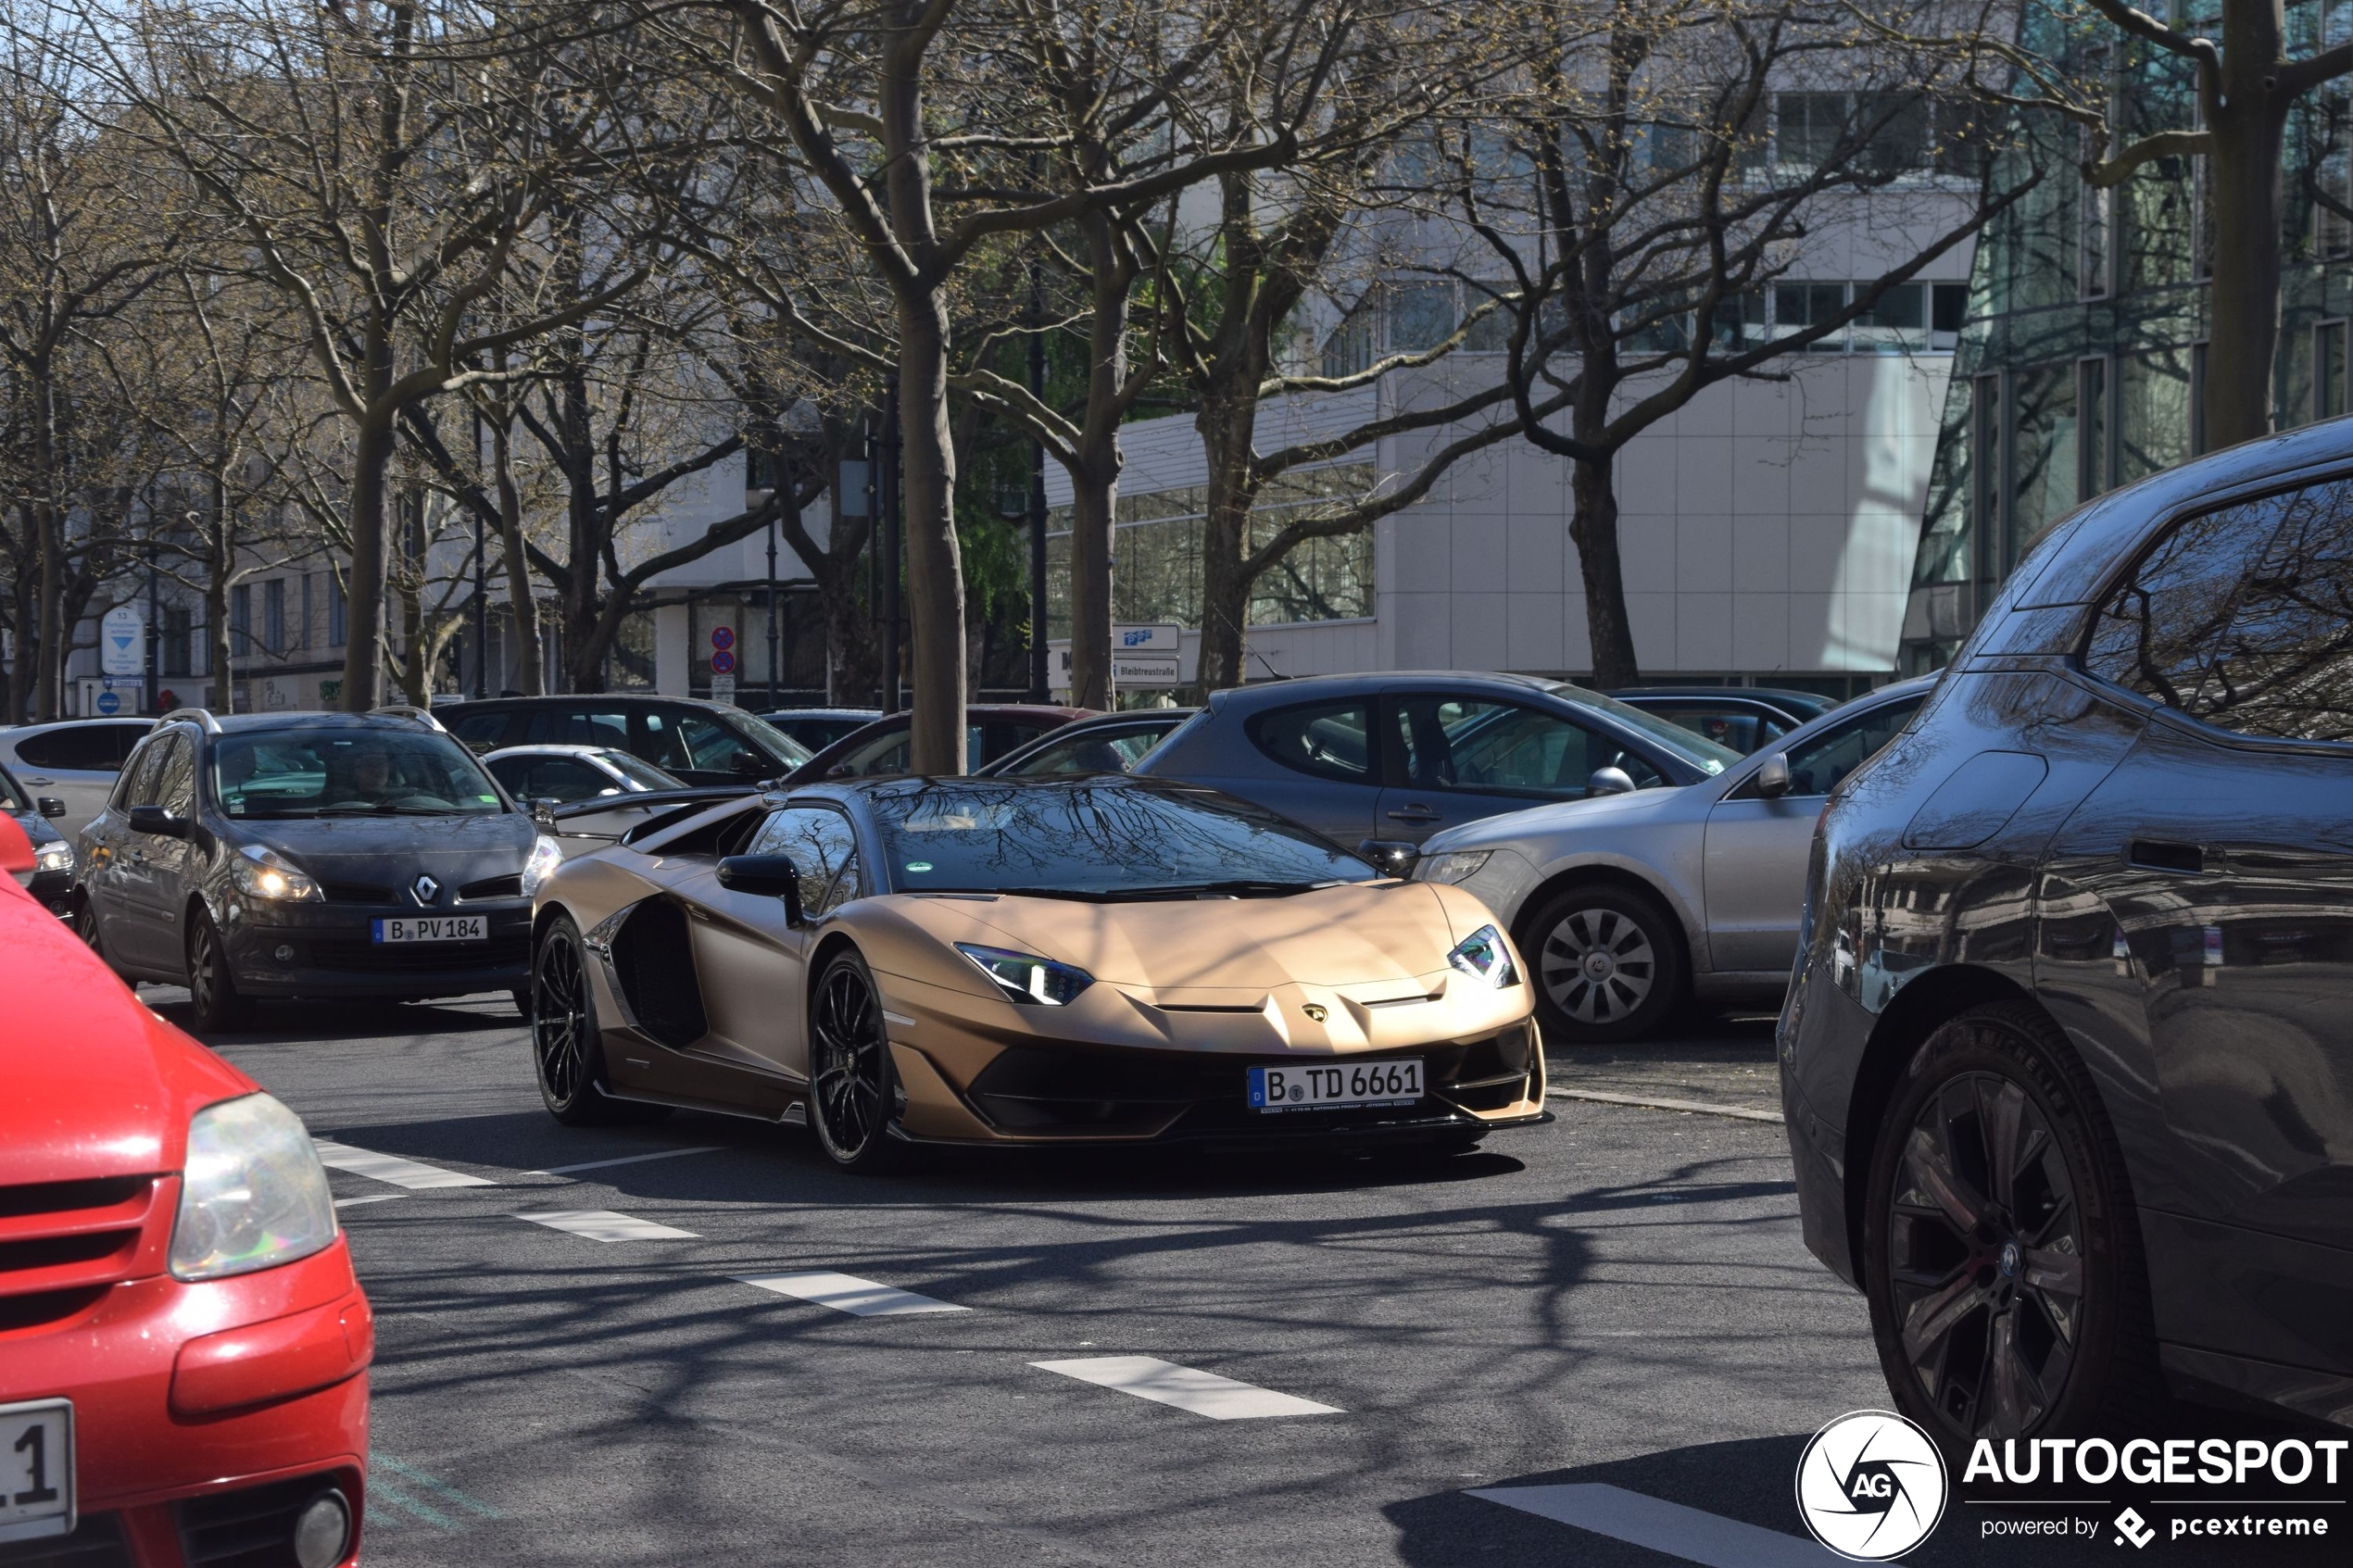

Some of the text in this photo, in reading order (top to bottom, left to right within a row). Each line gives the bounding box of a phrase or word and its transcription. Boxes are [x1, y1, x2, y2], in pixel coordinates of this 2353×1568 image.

[1120, 666, 1175, 677] Bleibtreustraße
[392, 921, 403, 939] B
[418, 921, 441, 938] PV
[447, 919, 480, 937] 184
[1254, 1064, 1420, 1101] D B TD 6661
[1980, 1028, 2067, 1110] MICHELIN
[0, 1424, 57, 1507] 1
